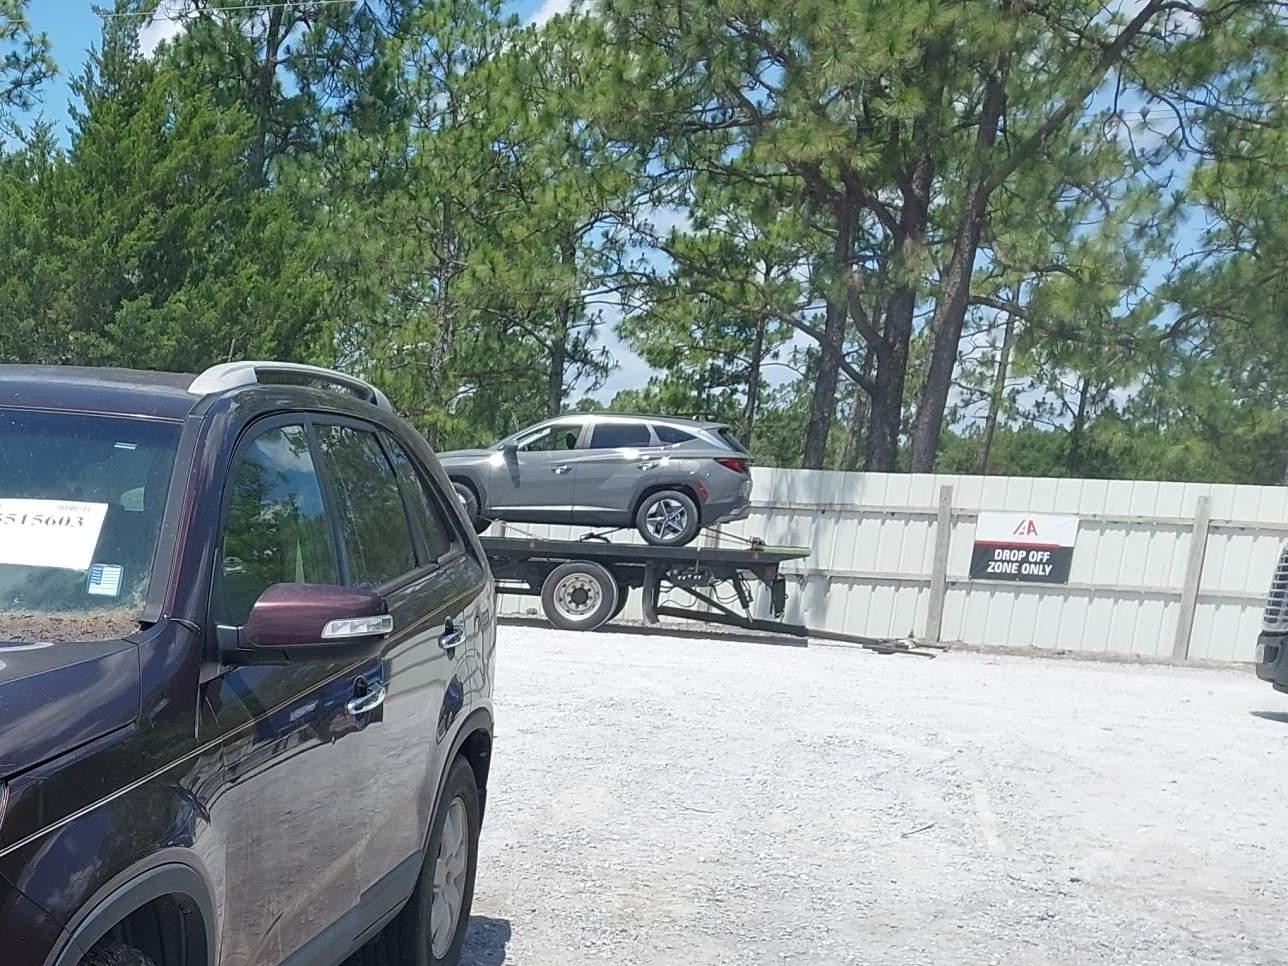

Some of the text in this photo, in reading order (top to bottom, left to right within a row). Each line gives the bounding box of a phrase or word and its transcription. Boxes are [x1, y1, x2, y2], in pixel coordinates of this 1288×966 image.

[994, 549, 1051, 563] DROP OFF
[986, 561, 1053, 576] ZONE ONLY
